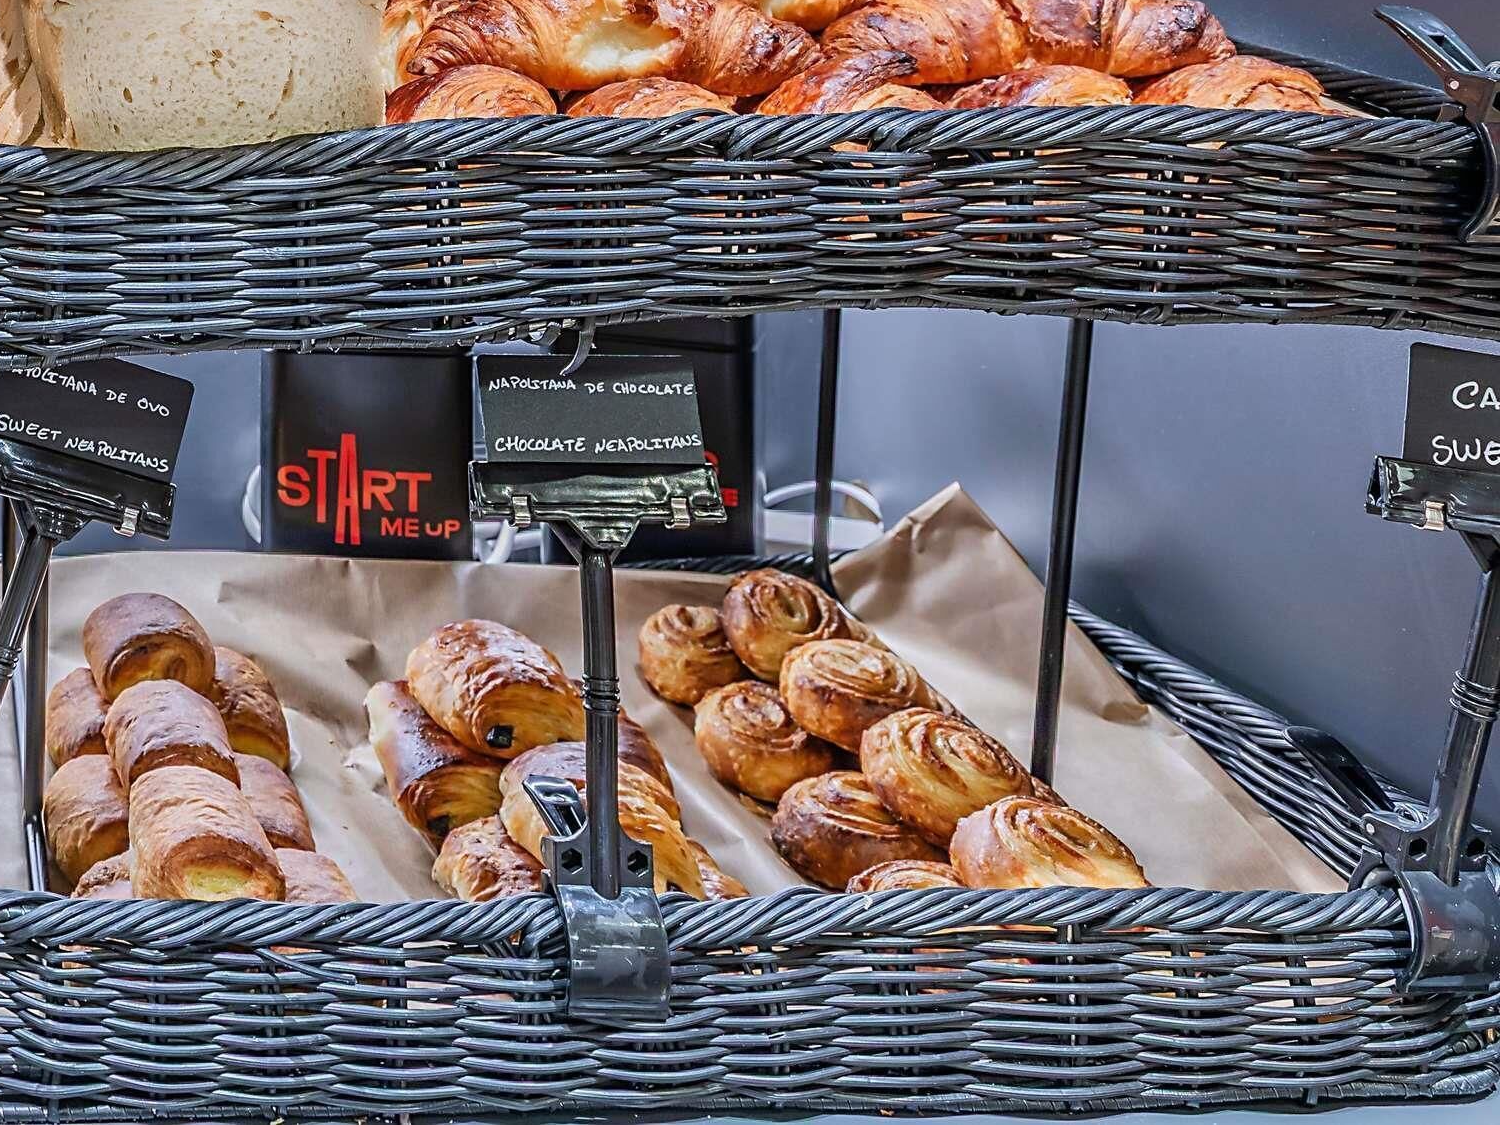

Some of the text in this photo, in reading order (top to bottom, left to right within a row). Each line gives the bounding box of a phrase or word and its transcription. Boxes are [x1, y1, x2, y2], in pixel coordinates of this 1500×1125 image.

[488, 376, 577, 392] NAPOLITANA
[584, 382, 605, 395] DE
[106, 389, 128, 404] DE
[137, 397, 170, 417] OVO
[494, 433, 702, 455] CHOCOLATE NEAPOLITANS
[277, 433, 432, 546] START
[380, 516, 419, 538] ME
